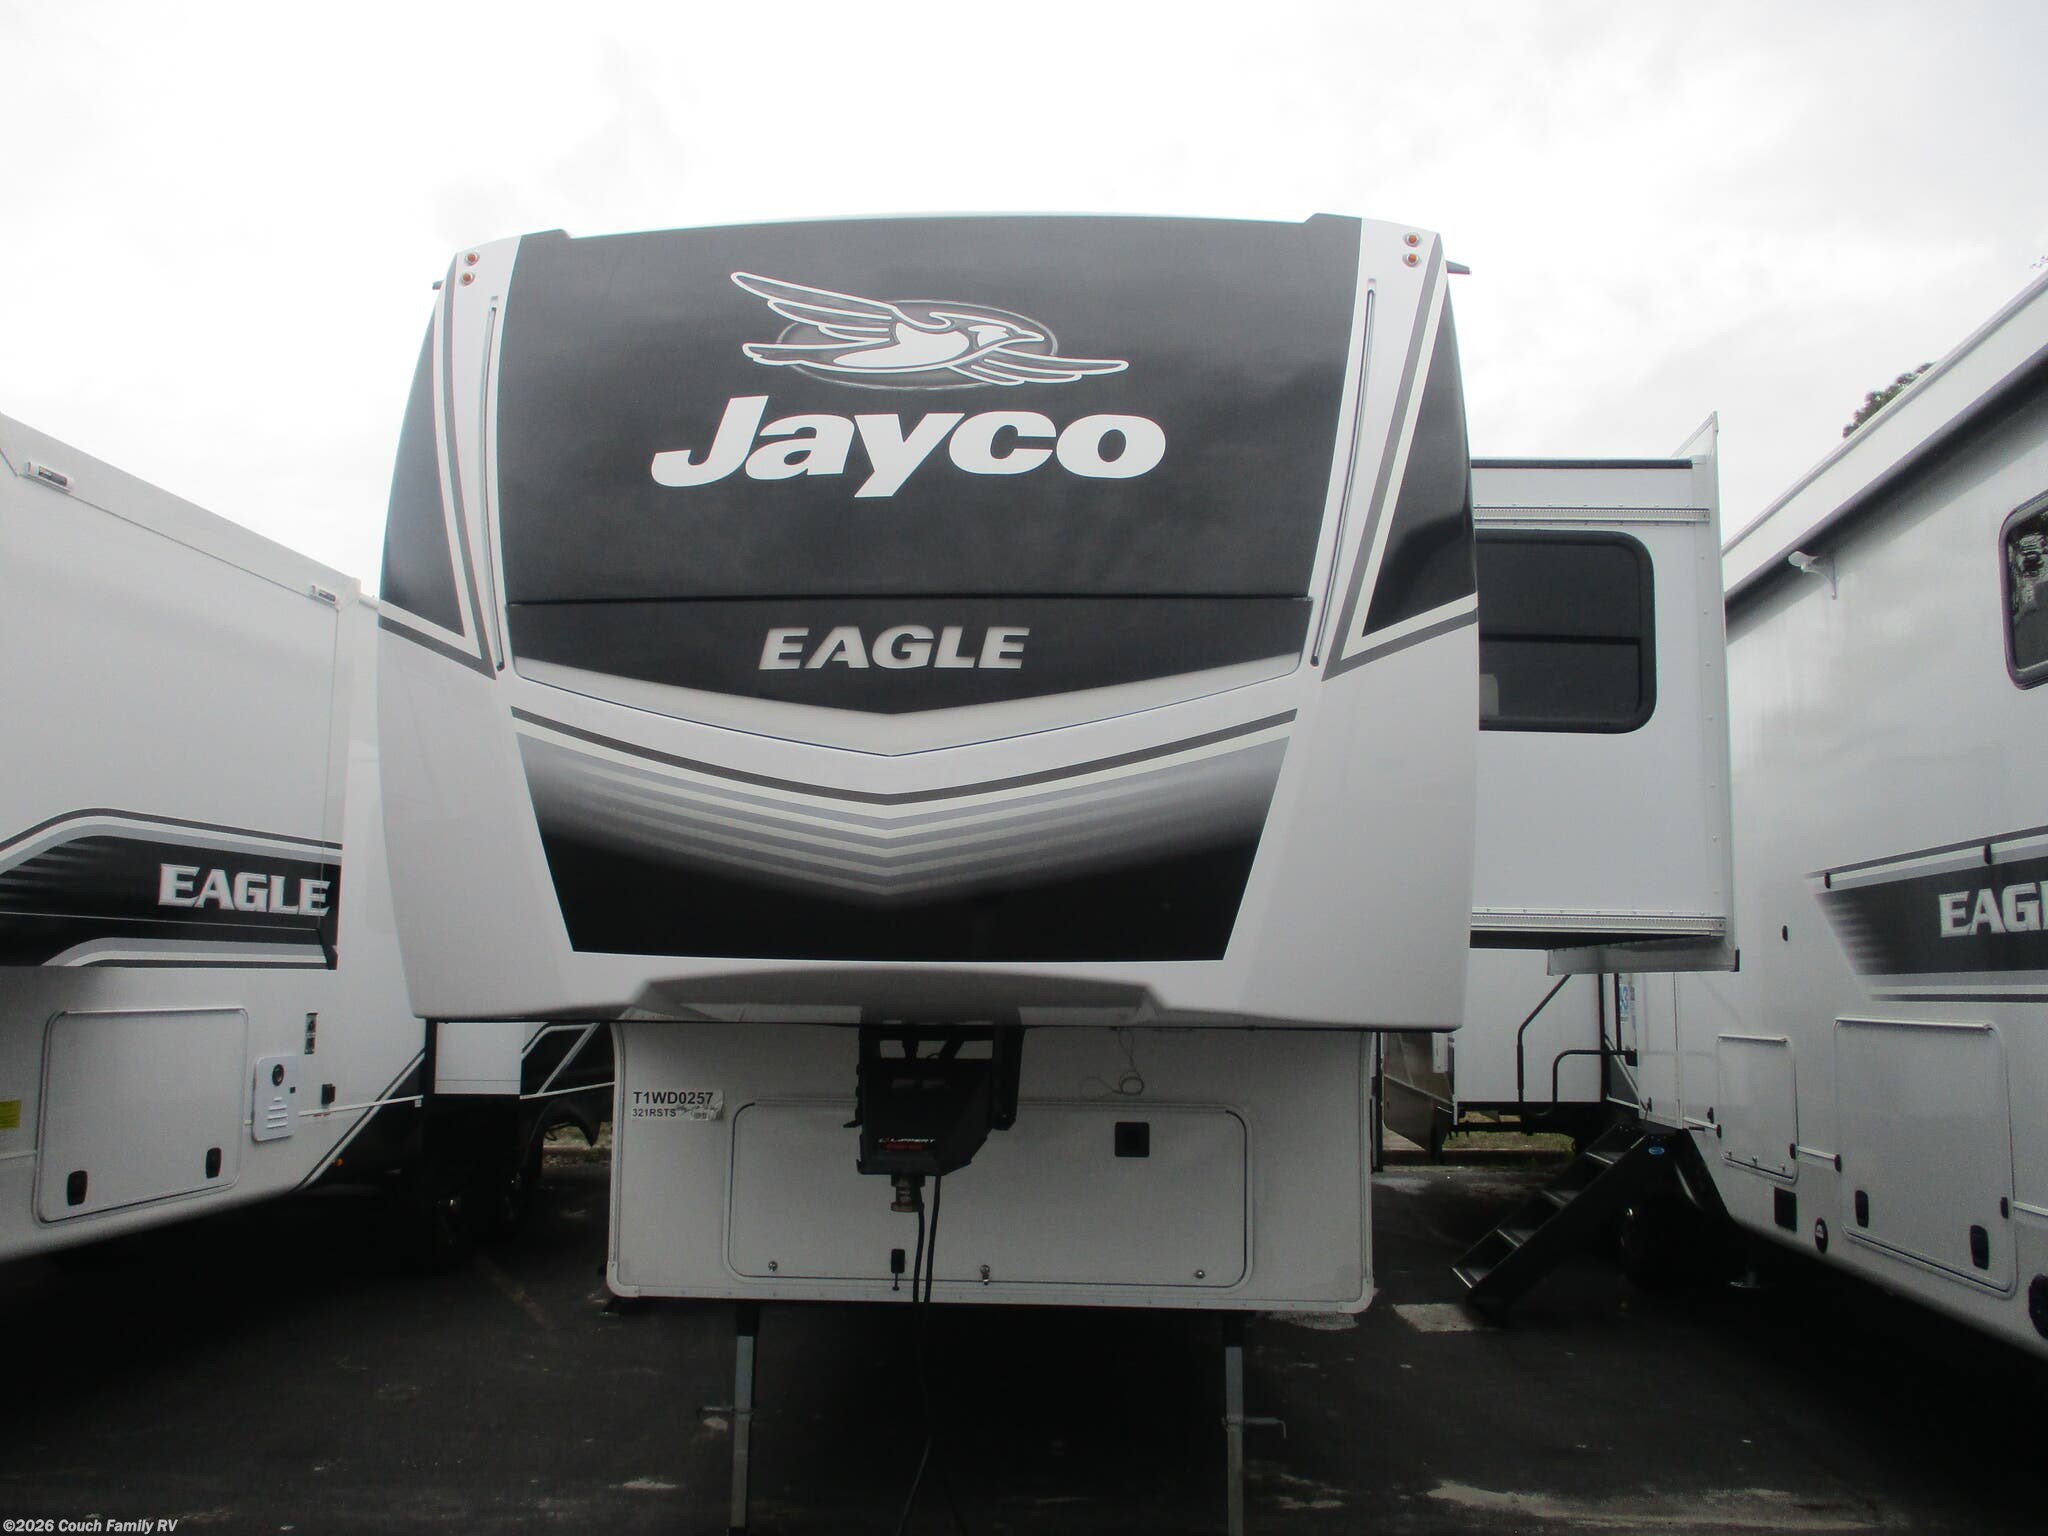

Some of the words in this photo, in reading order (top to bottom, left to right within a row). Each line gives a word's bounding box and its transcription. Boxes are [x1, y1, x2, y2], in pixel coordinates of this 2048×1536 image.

[651, 395, 1167, 498] Jayco
[758, 624, 1031, 670] EAGLE
[157, 863, 331, 917] EAGLE
[1938, 880, 2048, 938] EAG
[632, 1107, 677, 1118] 321RSTS
[633, 1091, 714, 1105] T1WD0257
